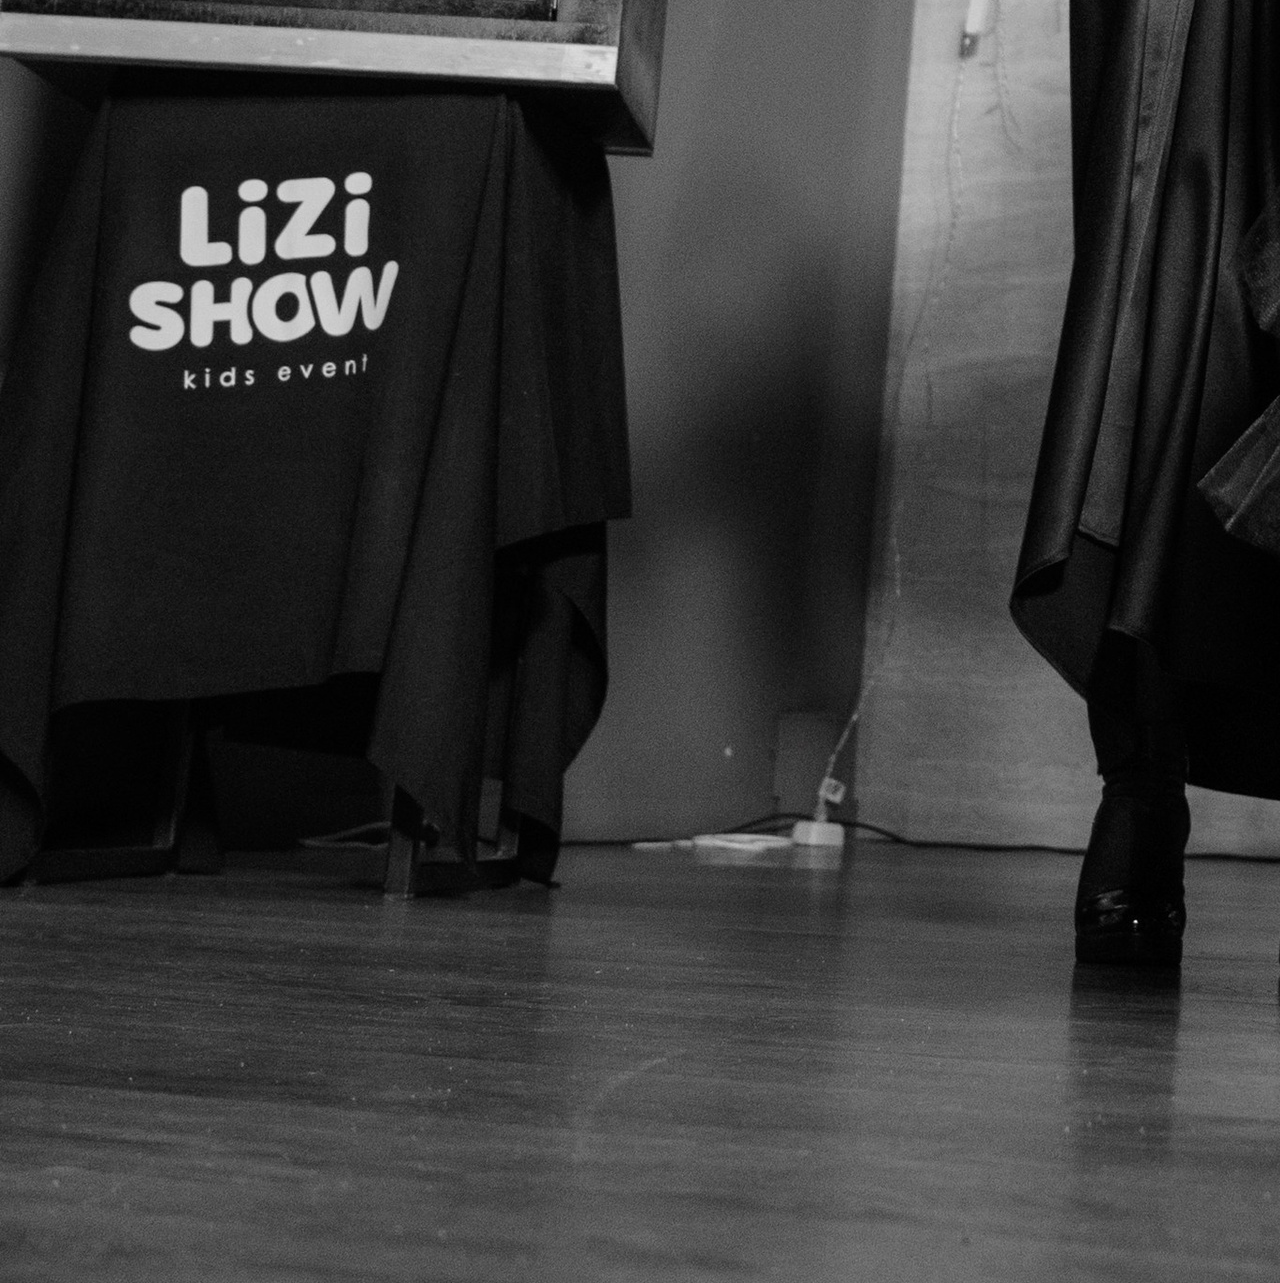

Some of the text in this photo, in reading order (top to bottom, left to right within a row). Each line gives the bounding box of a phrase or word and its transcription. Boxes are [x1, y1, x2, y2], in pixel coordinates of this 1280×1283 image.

[129, 260, 399, 351] SHOW
[183, 353, 369, 390] kids event
